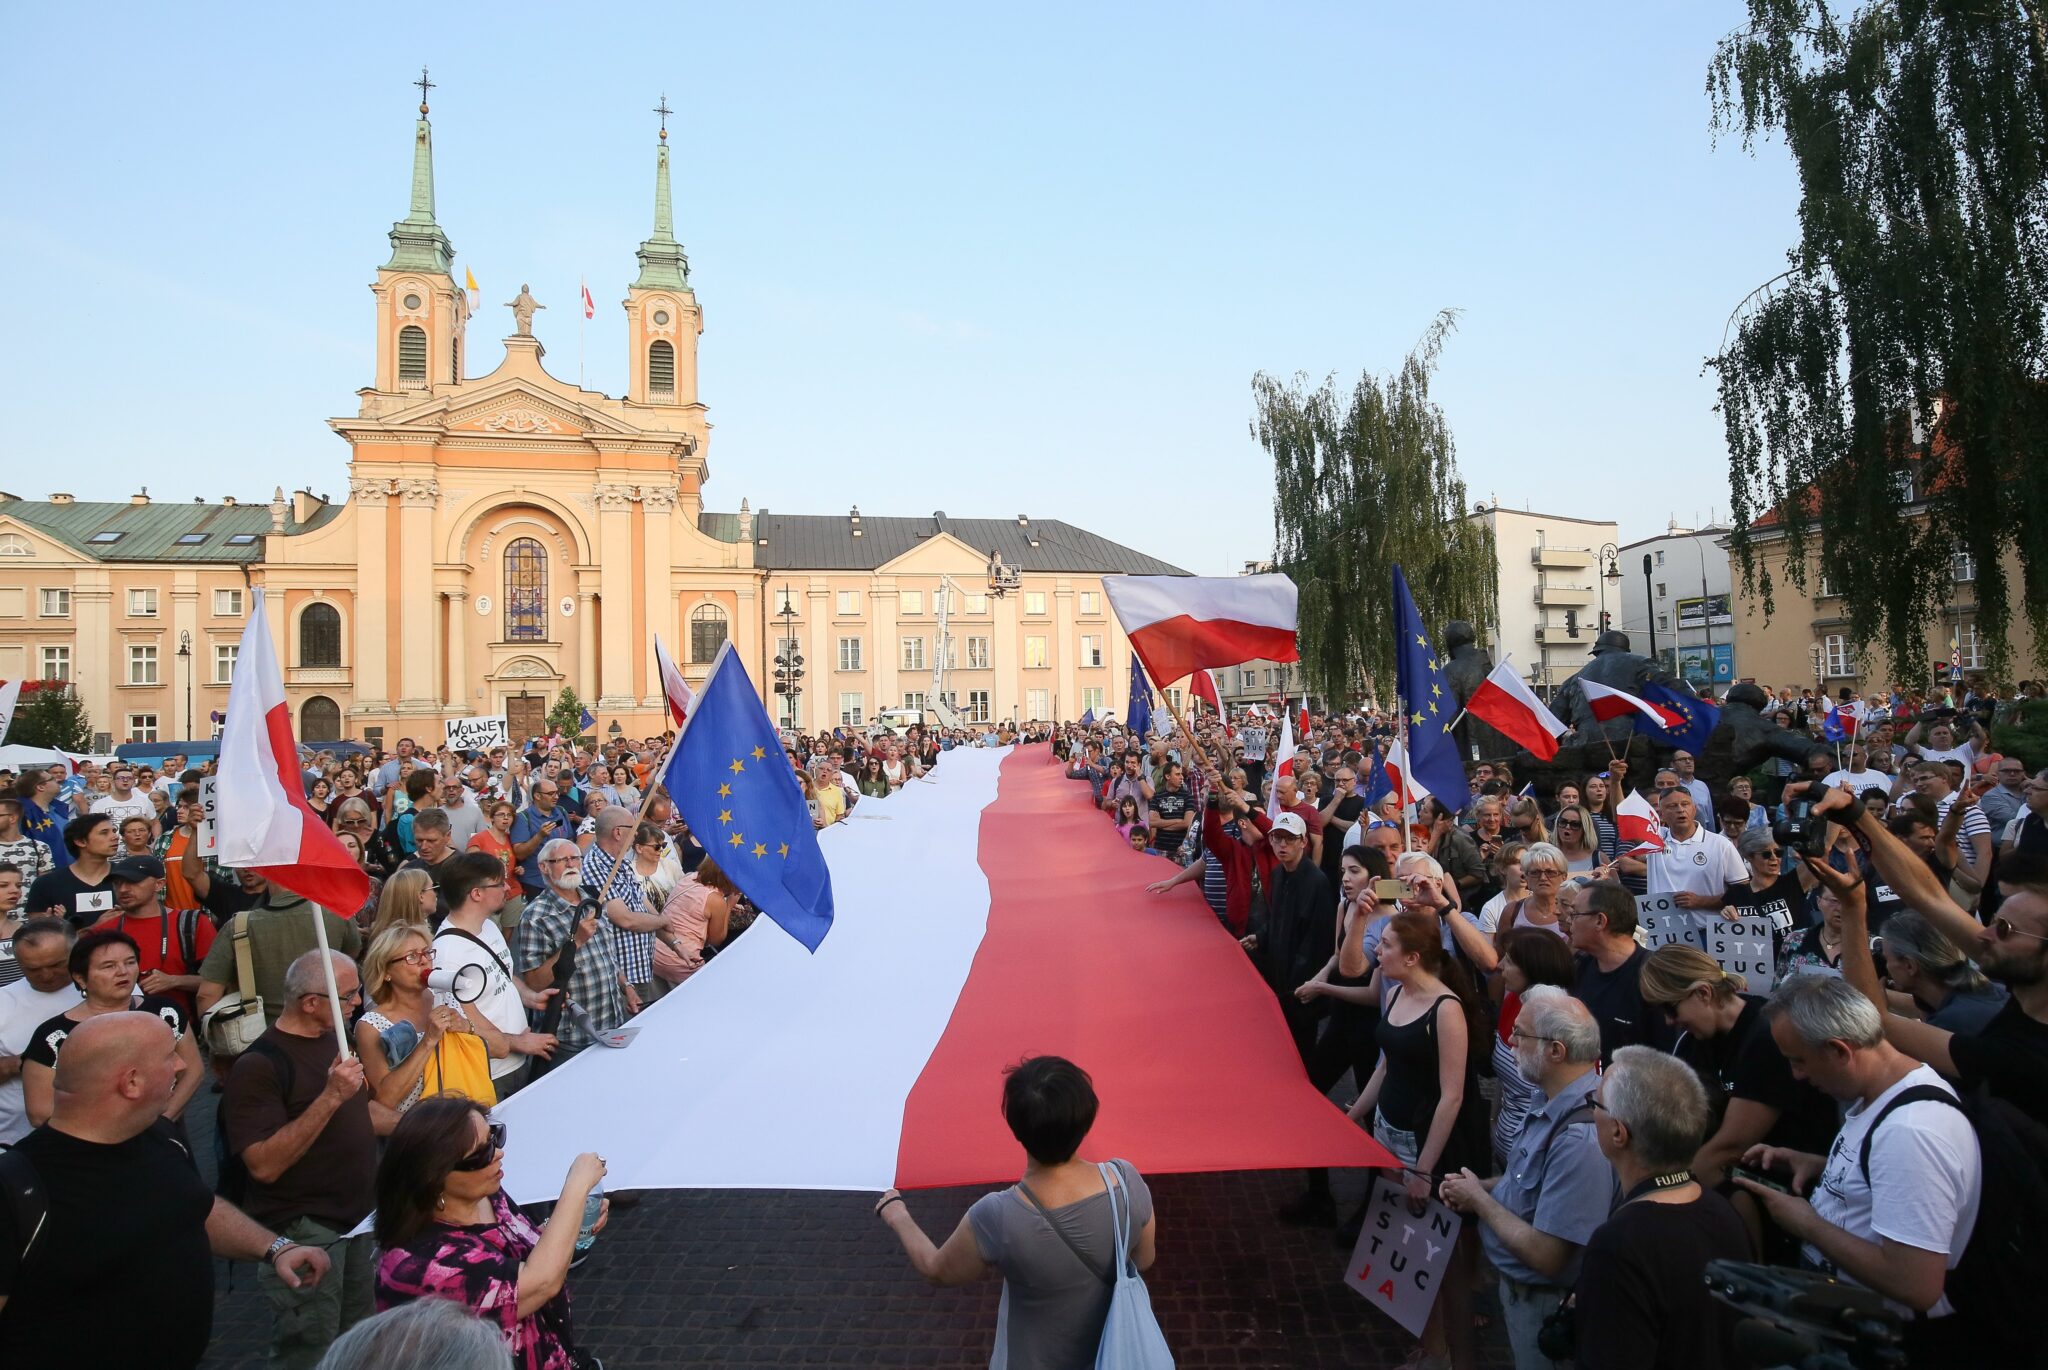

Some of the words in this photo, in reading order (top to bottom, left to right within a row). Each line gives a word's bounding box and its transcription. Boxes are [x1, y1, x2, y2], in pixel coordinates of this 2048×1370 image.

[1647, 914, 1689, 930] STY
[1714, 922, 1766, 937] KON
[1650, 931, 1694, 946] TUC
[1715, 941, 1766, 956] STY
[1716, 959, 1766, 974] TUC
[1376, 1211, 1442, 1262] STY
[1370, 1236, 1429, 1291] TUC
[1358, 1263, 1394, 1302] JA
